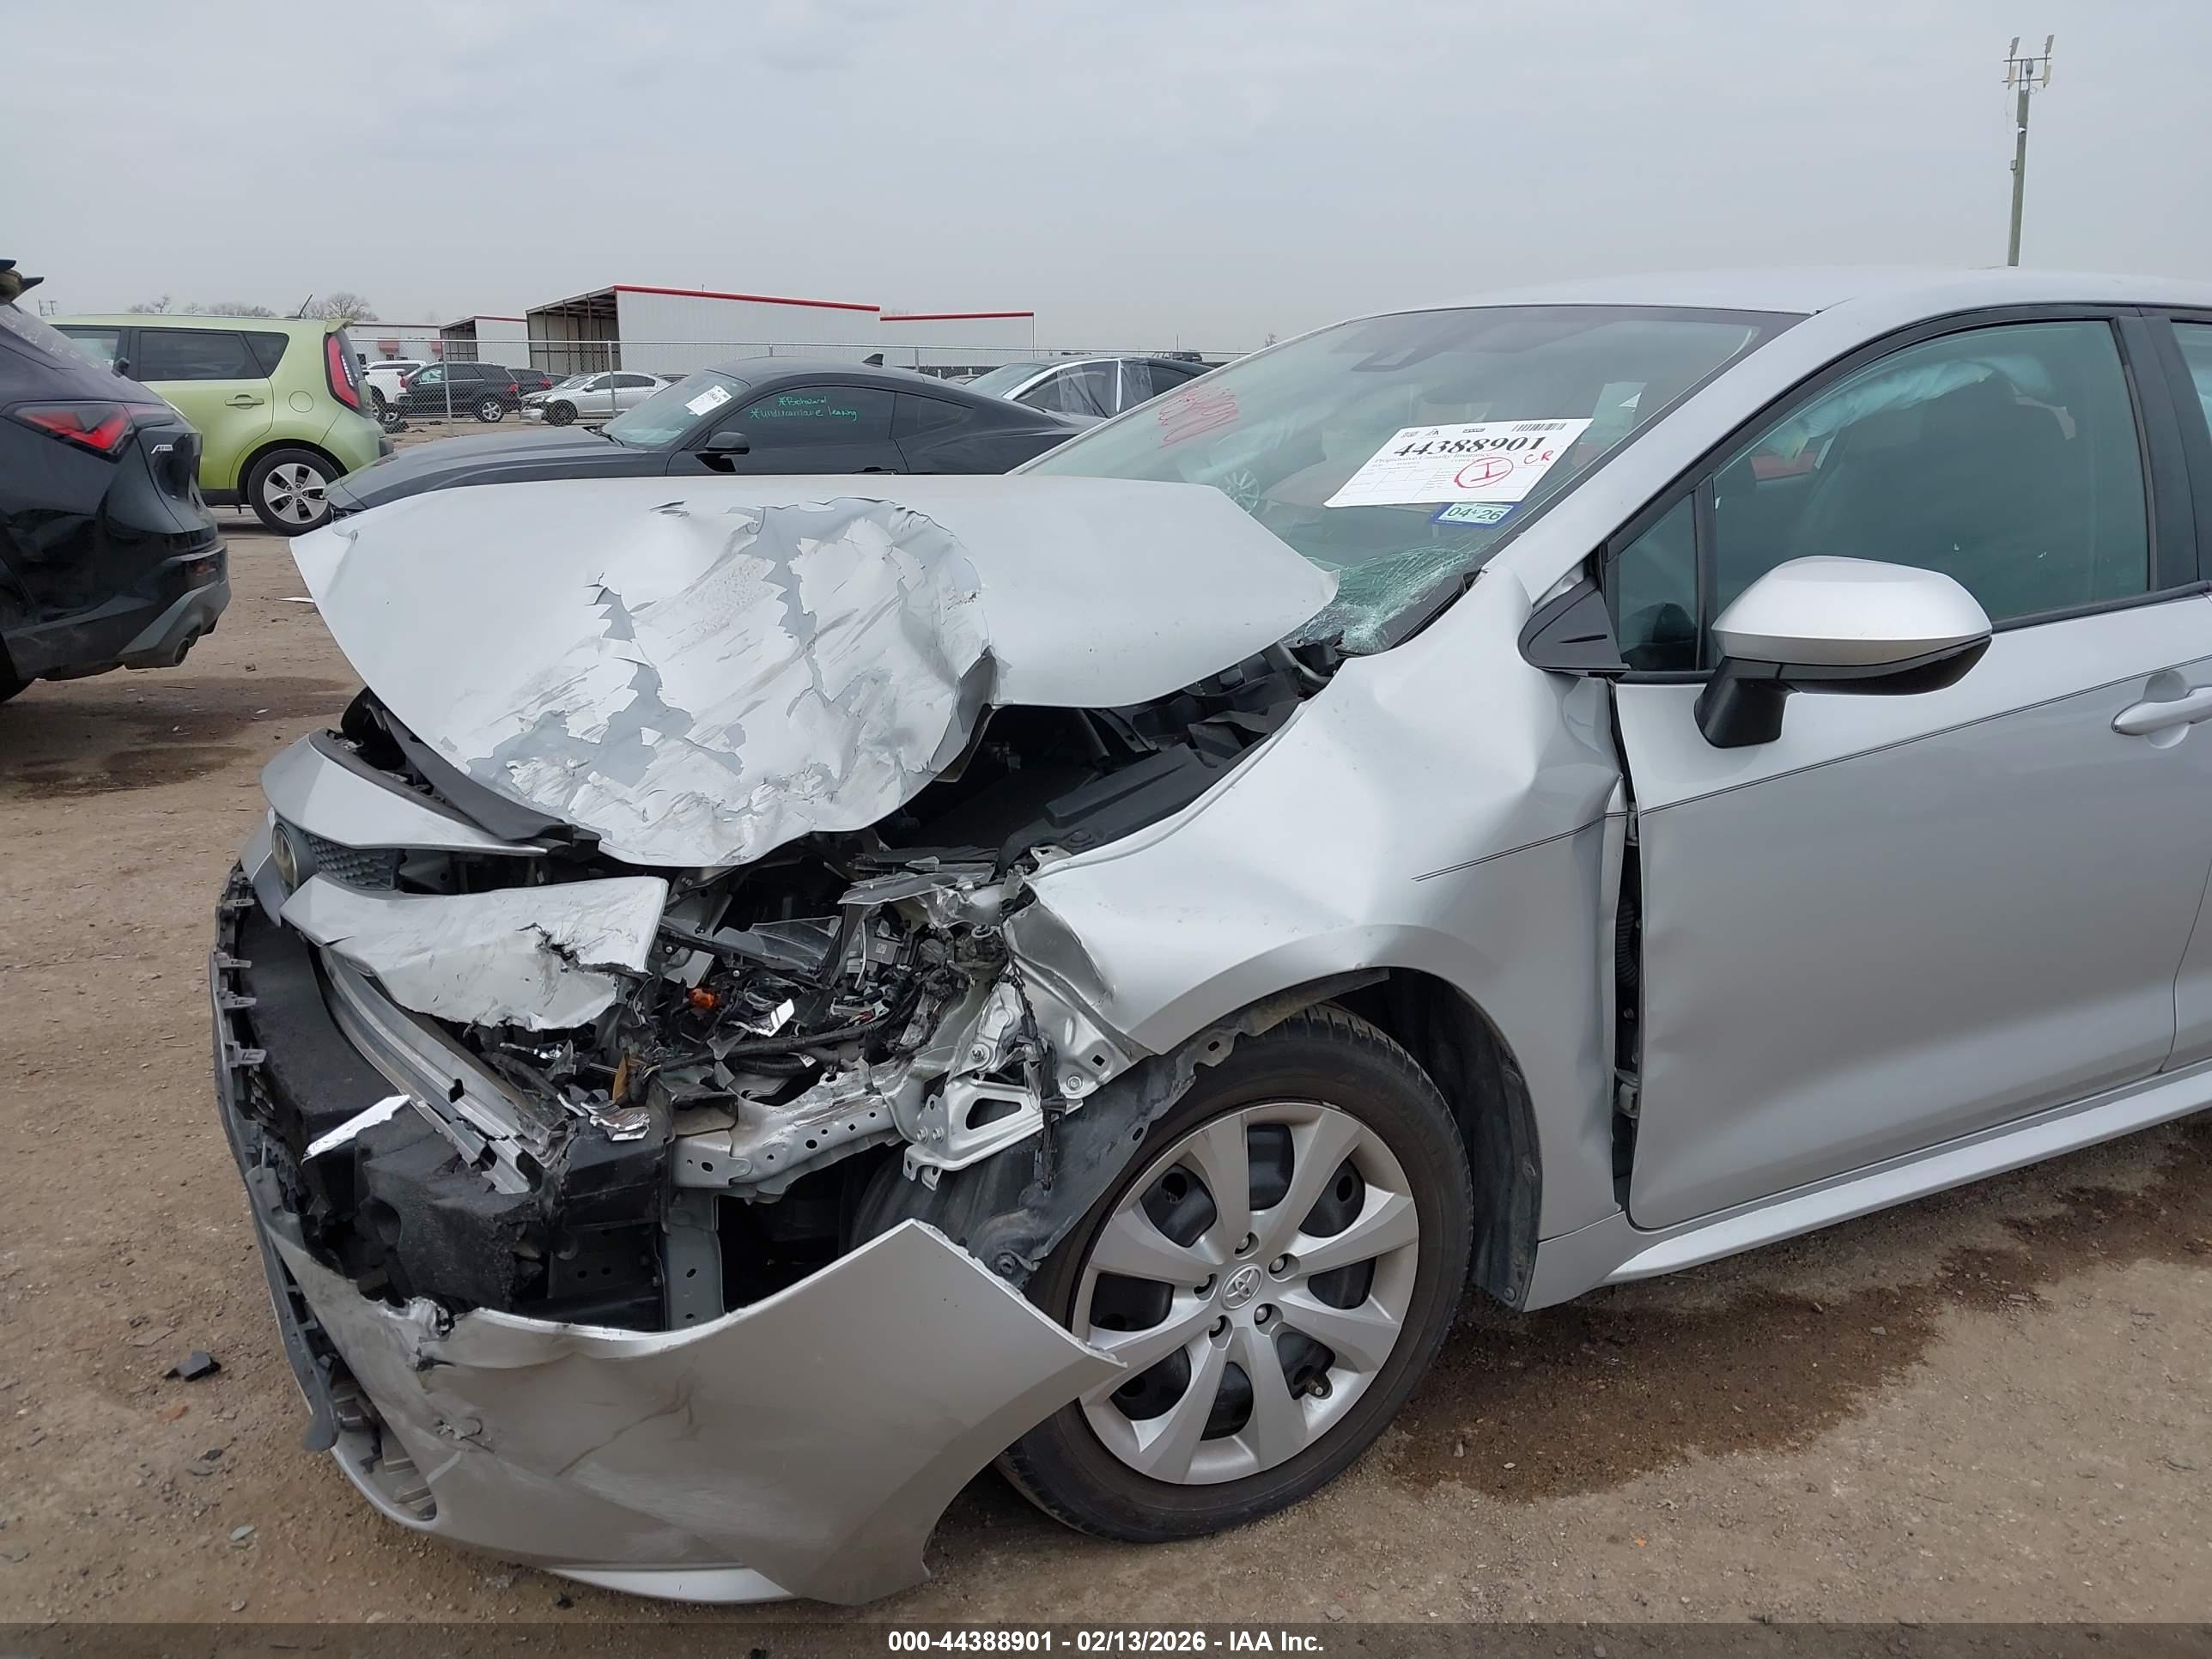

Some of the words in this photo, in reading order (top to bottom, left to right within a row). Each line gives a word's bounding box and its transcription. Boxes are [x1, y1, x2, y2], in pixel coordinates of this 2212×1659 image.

[1394, 436, 1547, 457] 44388901
[1447, 507, 1471, 518] 04
[1477, 509, 1504, 520] 26
